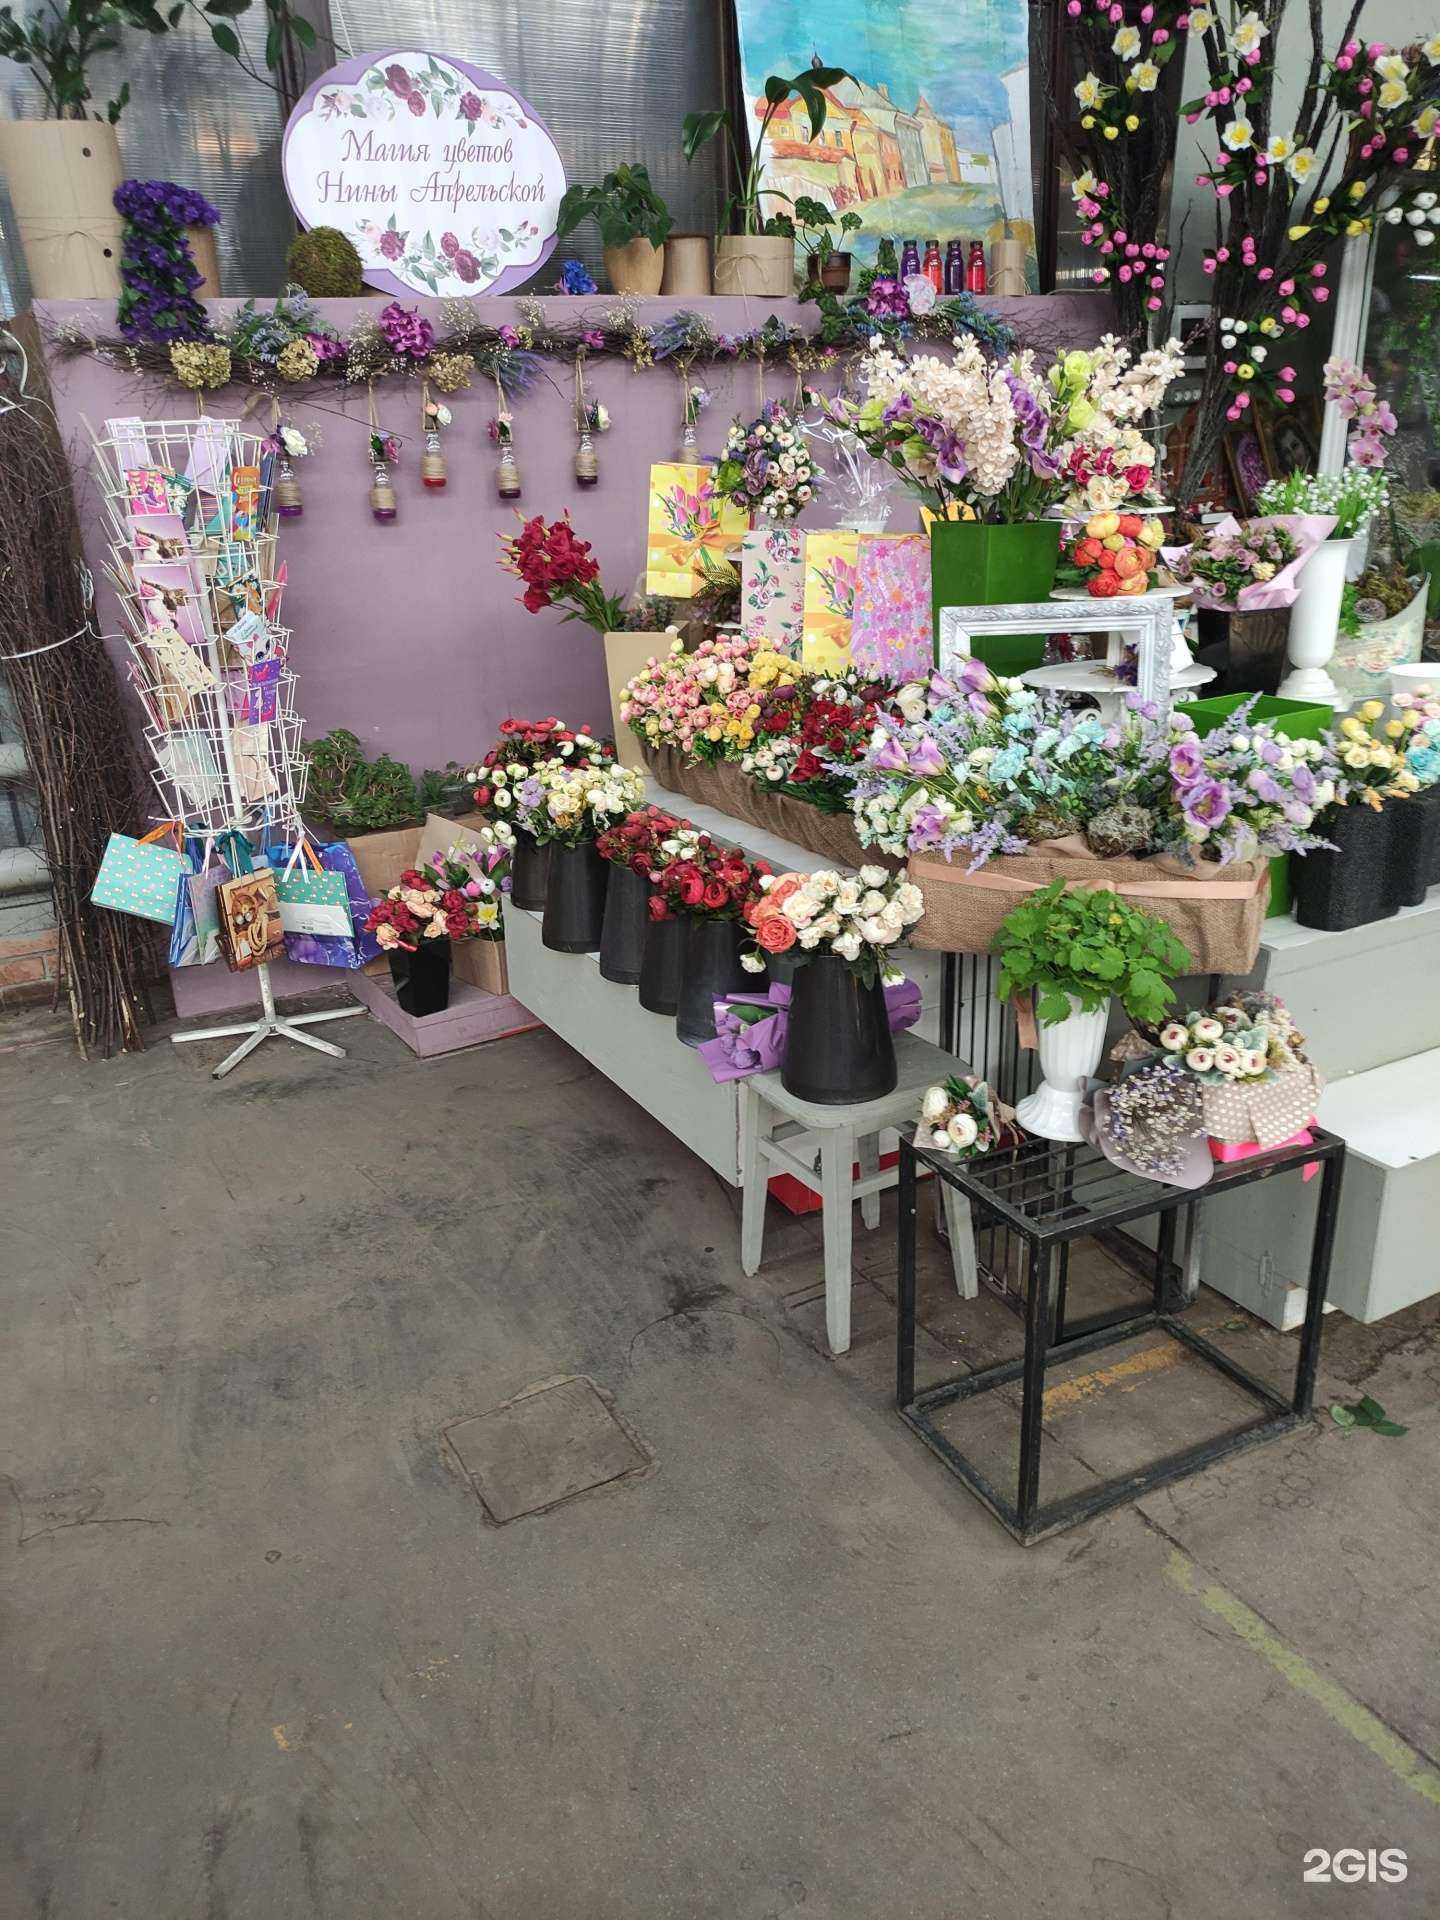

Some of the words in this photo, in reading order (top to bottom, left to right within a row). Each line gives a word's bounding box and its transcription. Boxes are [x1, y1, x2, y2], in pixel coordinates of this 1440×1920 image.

[341, 129, 431, 162] Магия
[443, 137, 513, 173] цветов
[317, 170, 398, 203] Нины
[410, 170, 546, 213] Апрельской
